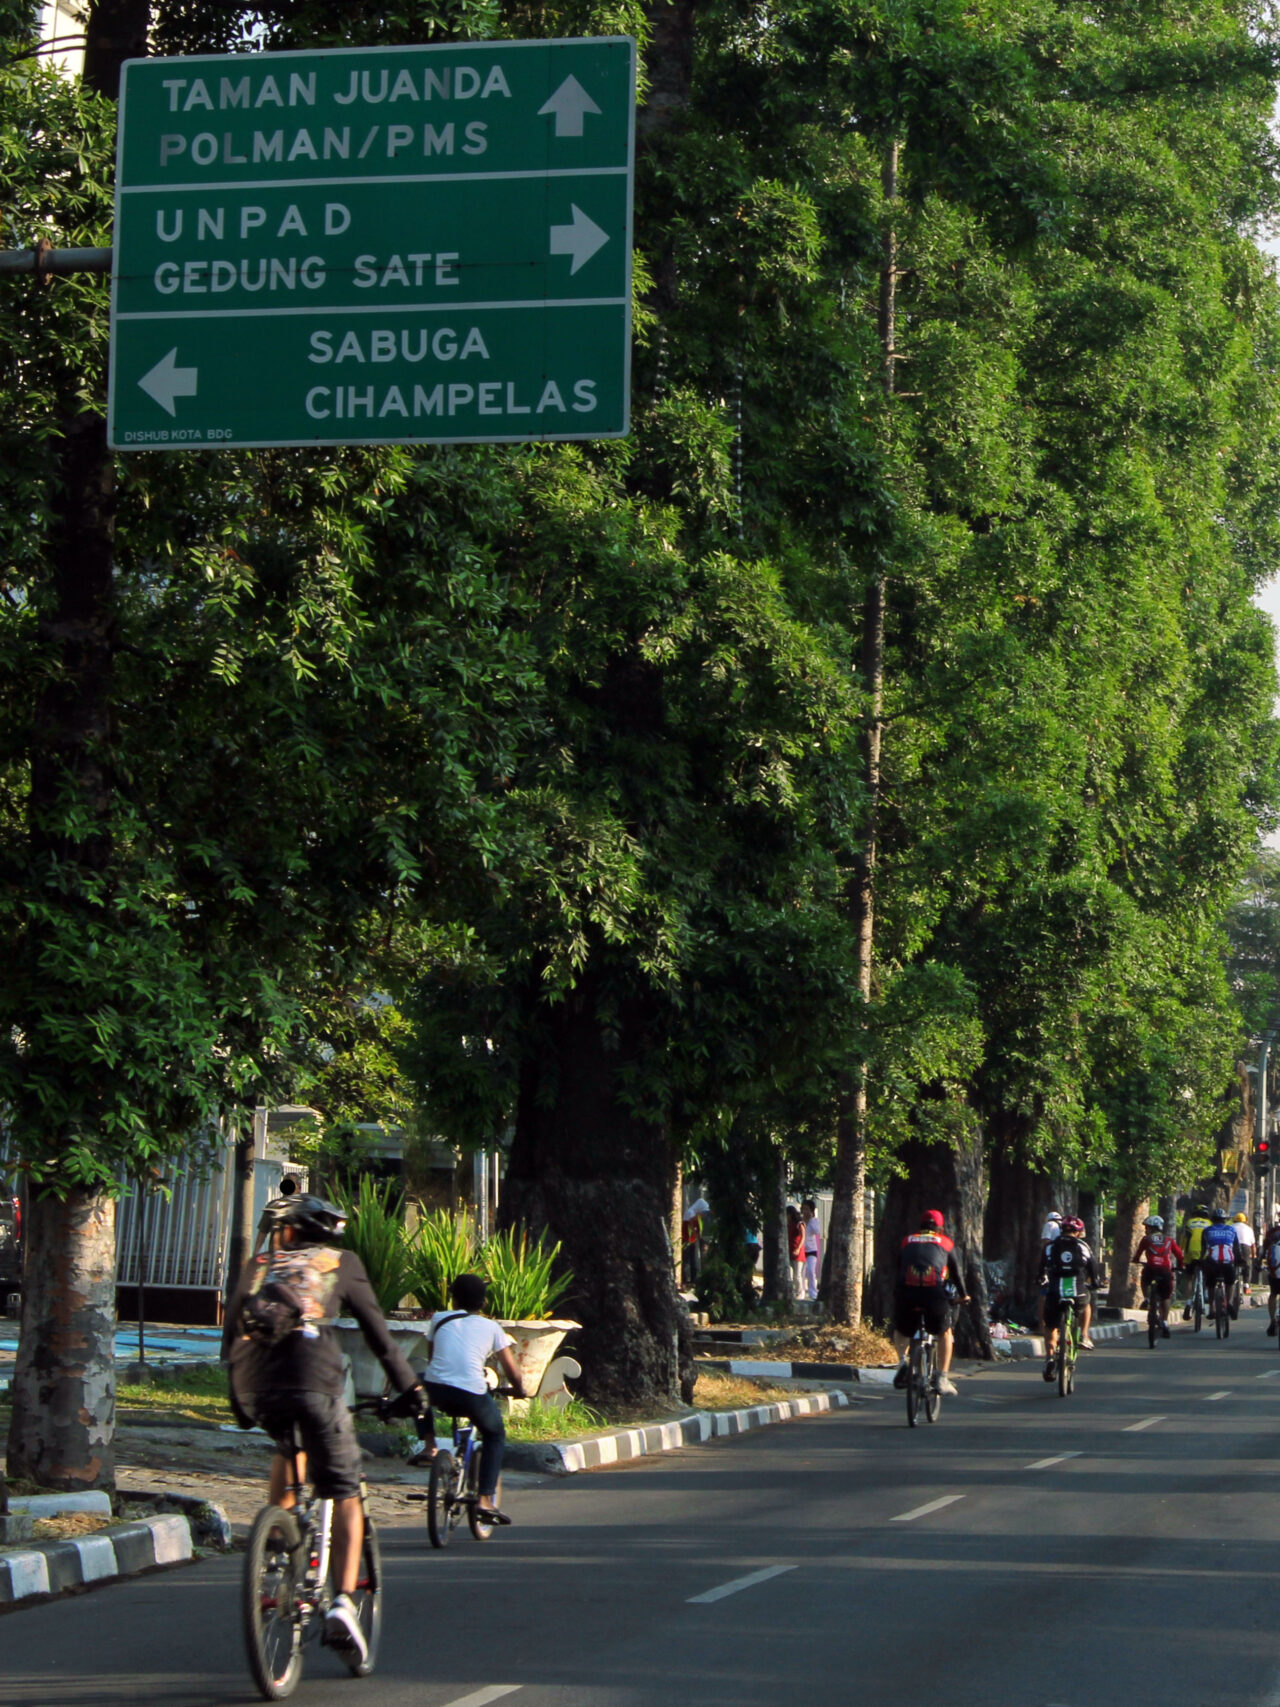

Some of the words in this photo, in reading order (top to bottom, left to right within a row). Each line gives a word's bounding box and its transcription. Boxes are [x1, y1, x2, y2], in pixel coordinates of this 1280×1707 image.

[162, 73, 316, 112] TAMAN
[334, 65, 512, 105] JUANDA
[159, 121, 488, 167] POLMAN/PMS
[156, 203, 351, 242] UNPAD
[154, 256, 327, 294] GEDUNG
[353, 252, 460, 288] SATE
[308, 327, 490, 364] SABUGA
[305, 379, 597, 419] CIHAMPELAS
[124, 431, 169, 442] DISHUB
[171, 429, 202, 440] KOTA
[206, 429, 233, 440] BDG
